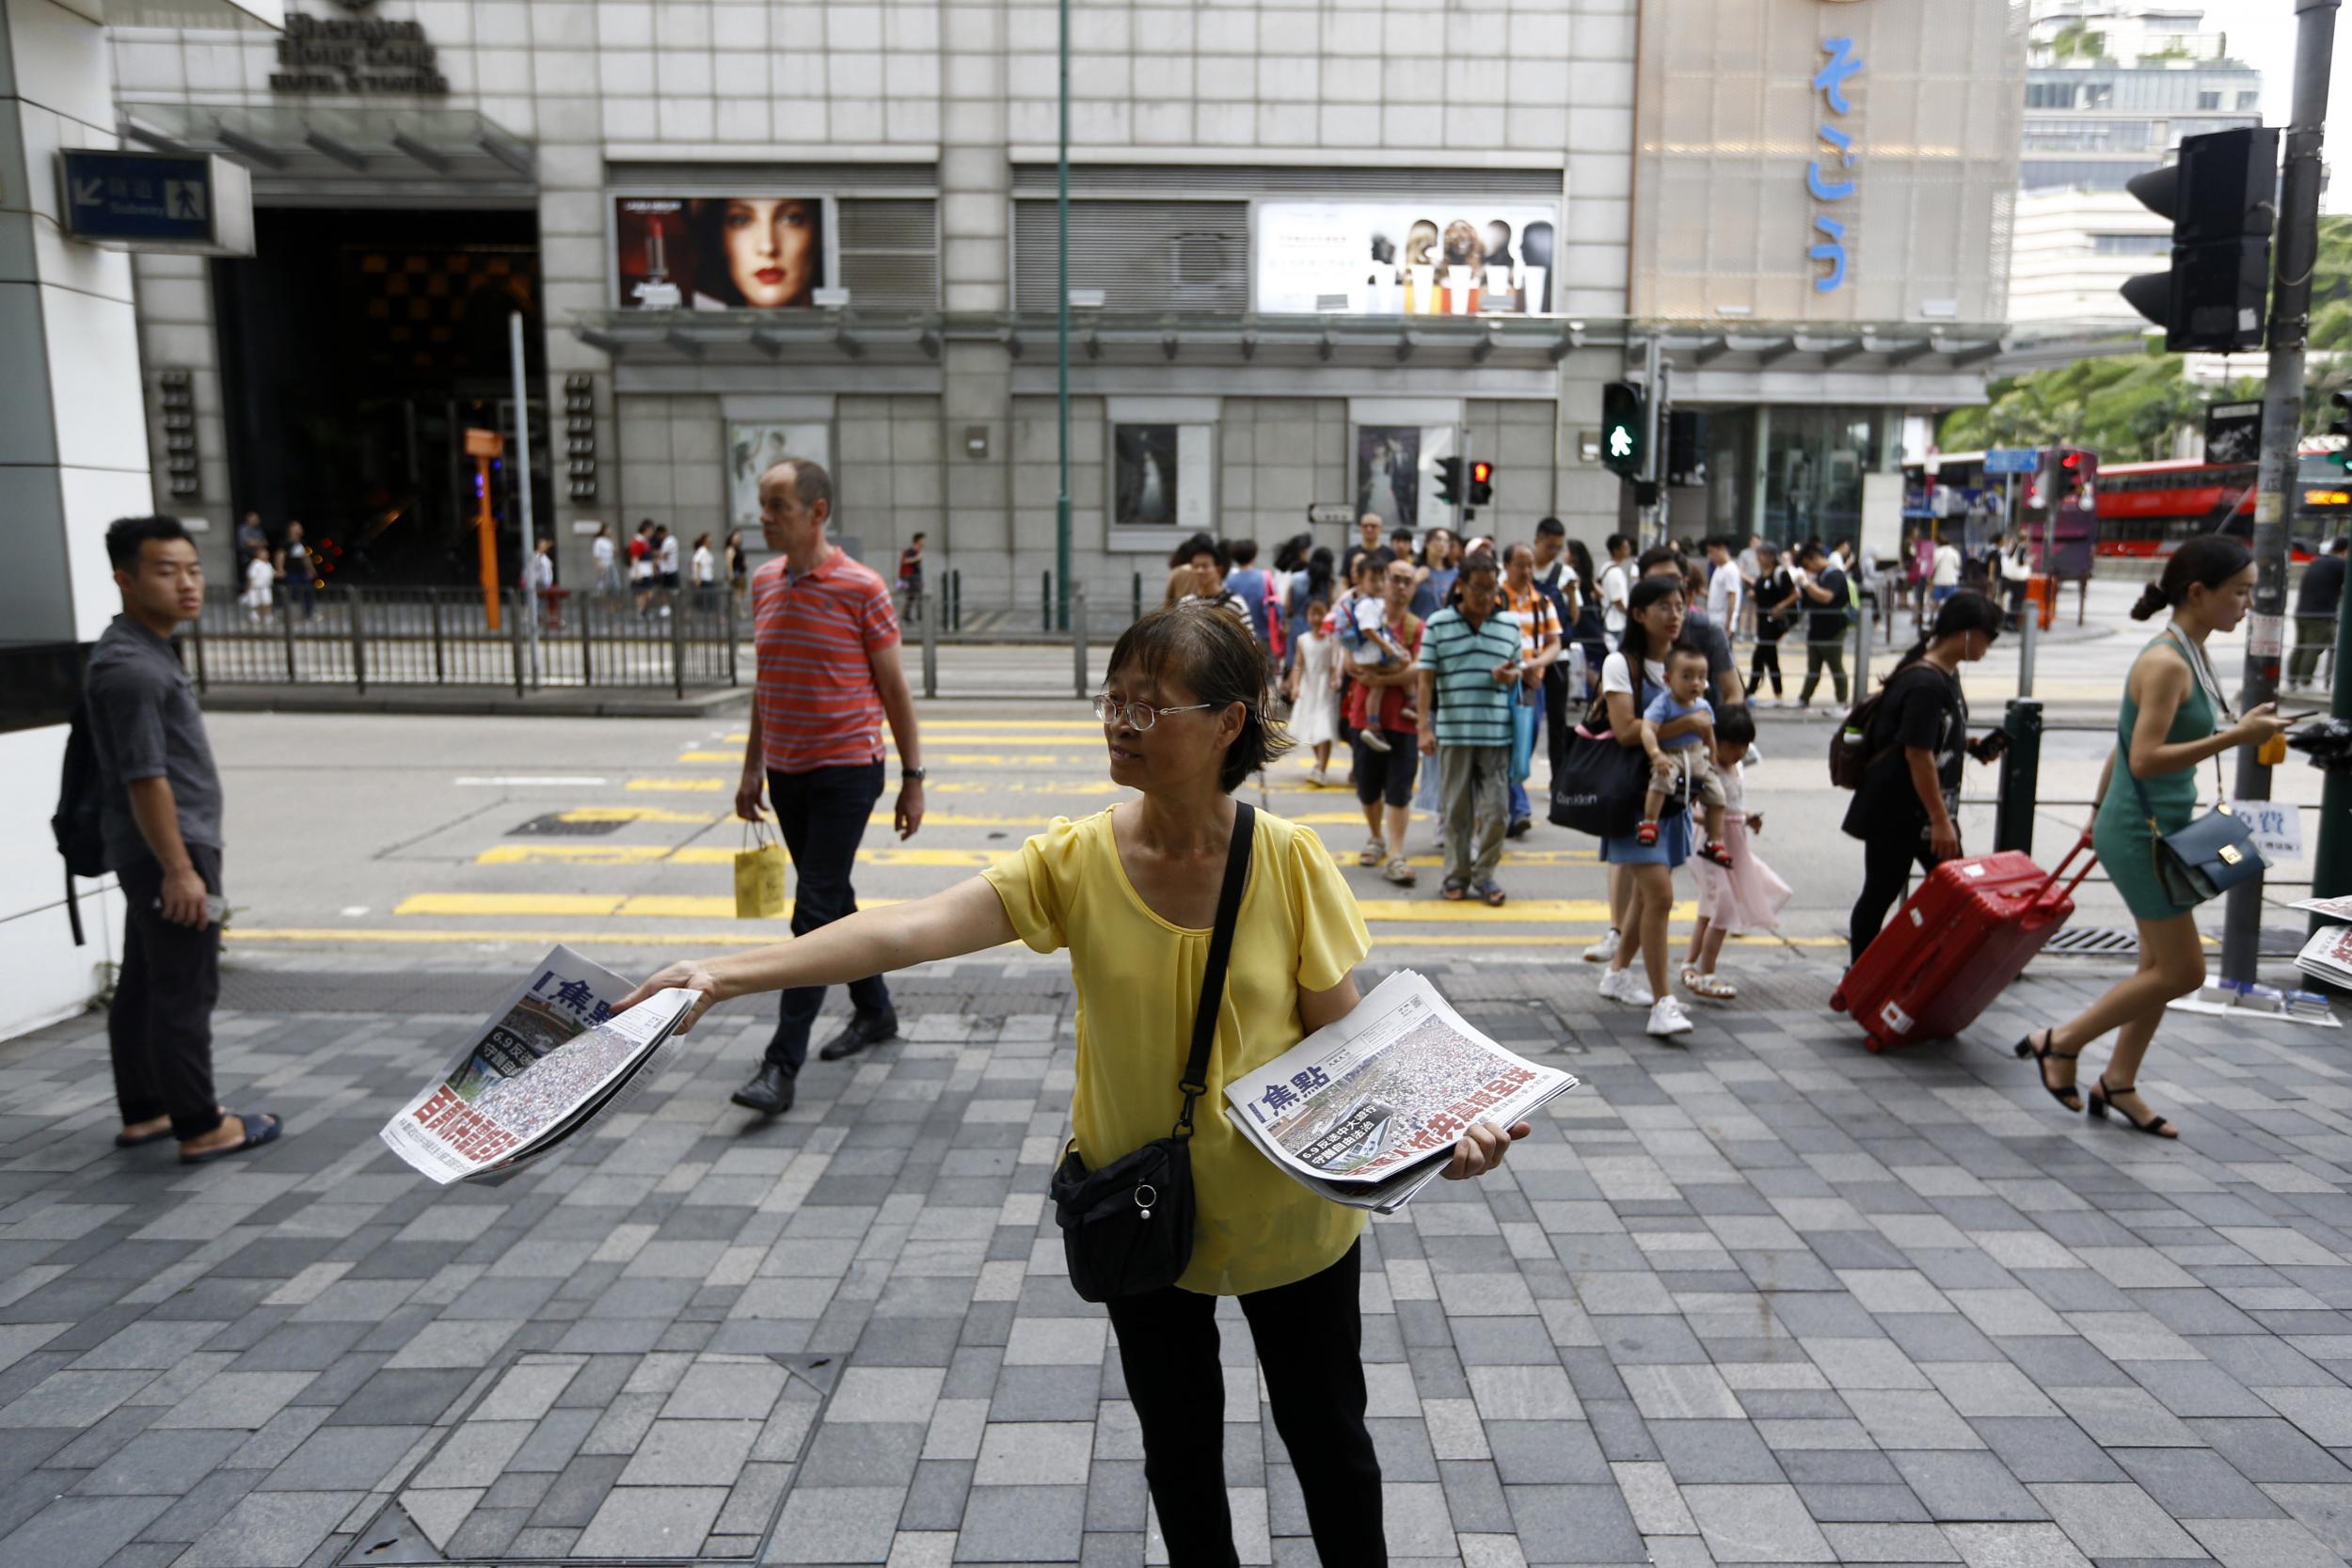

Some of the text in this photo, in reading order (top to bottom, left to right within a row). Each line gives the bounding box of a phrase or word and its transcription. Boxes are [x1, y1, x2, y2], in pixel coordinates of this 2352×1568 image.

[482, 1042, 521, 1079] 守護自
[1262, 1066, 1331, 1115] 焦點
[1311, 1119, 1375, 1165] 守護自由法治
